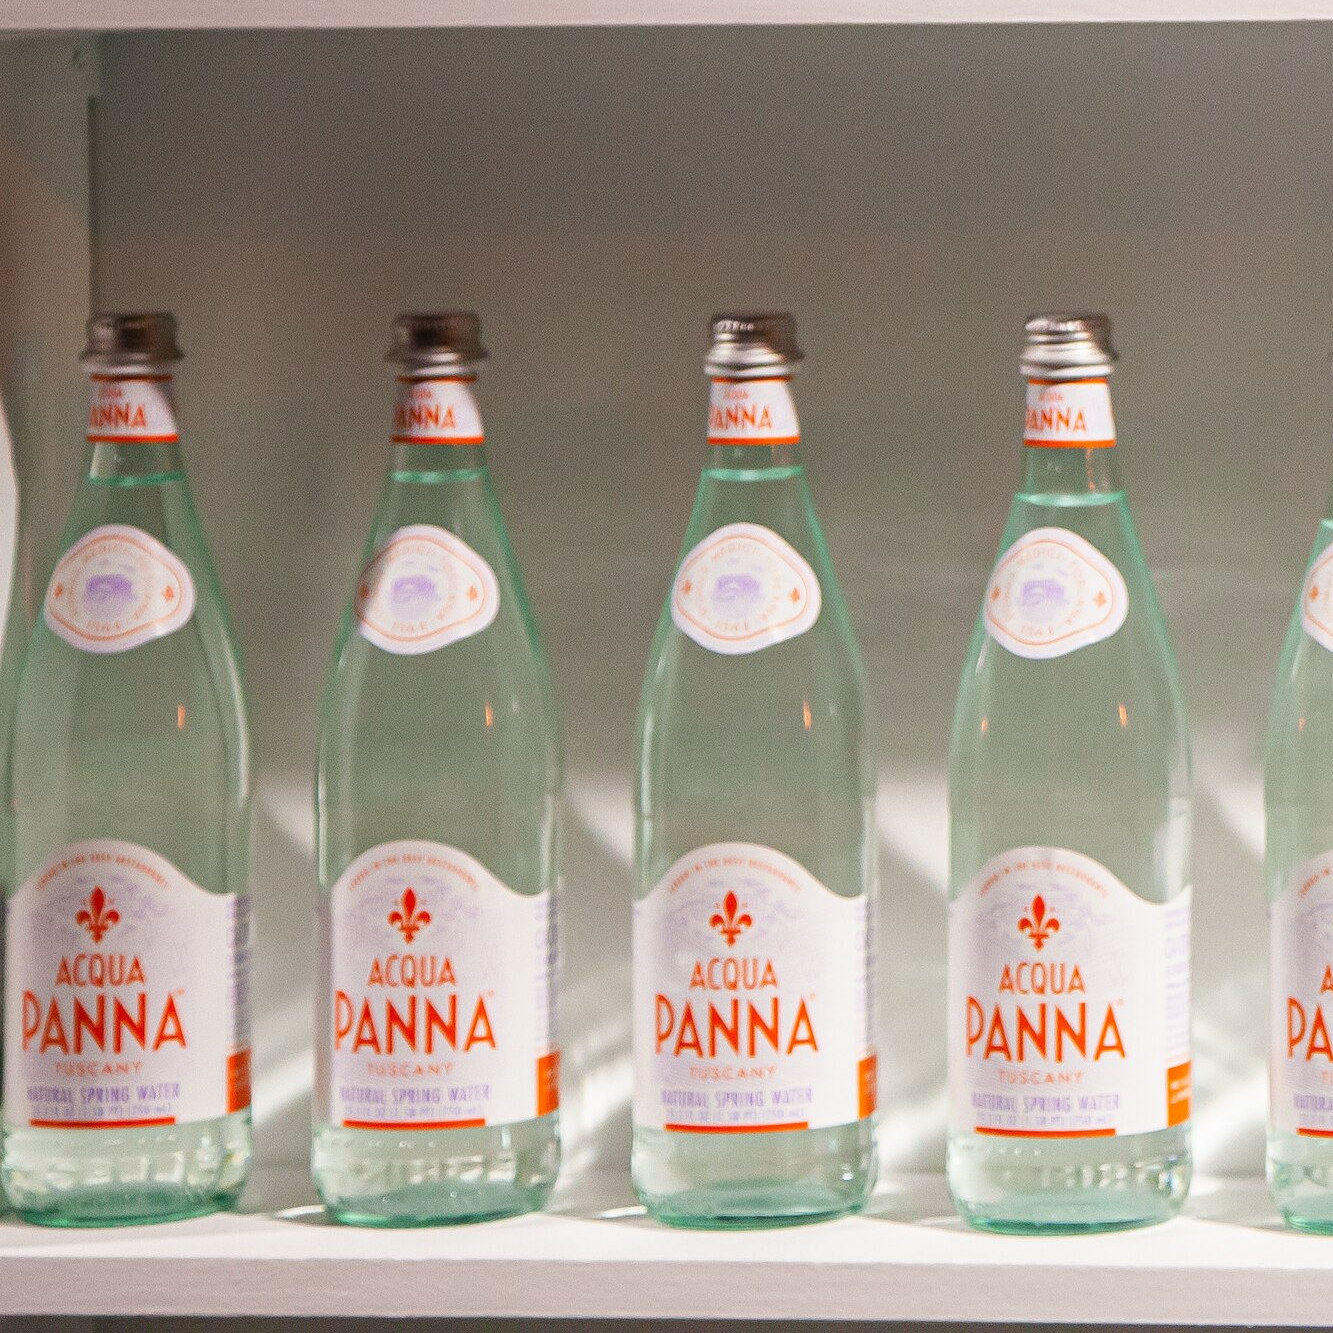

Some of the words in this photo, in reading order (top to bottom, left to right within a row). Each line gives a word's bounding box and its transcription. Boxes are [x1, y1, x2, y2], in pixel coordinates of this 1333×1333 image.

[58, 954, 144, 987] ACQUA
[370, 955, 456, 987] ACQUA
[691, 959, 777, 990] ACQUA
[1000, 963, 1084, 995] ACQUA
[23, 991, 186, 1054] PANNA
[335, 991, 496, 1055] PANNA
[656, 994, 818, 1058] PANNA
[967, 996, 1125, 1063] PANNA
